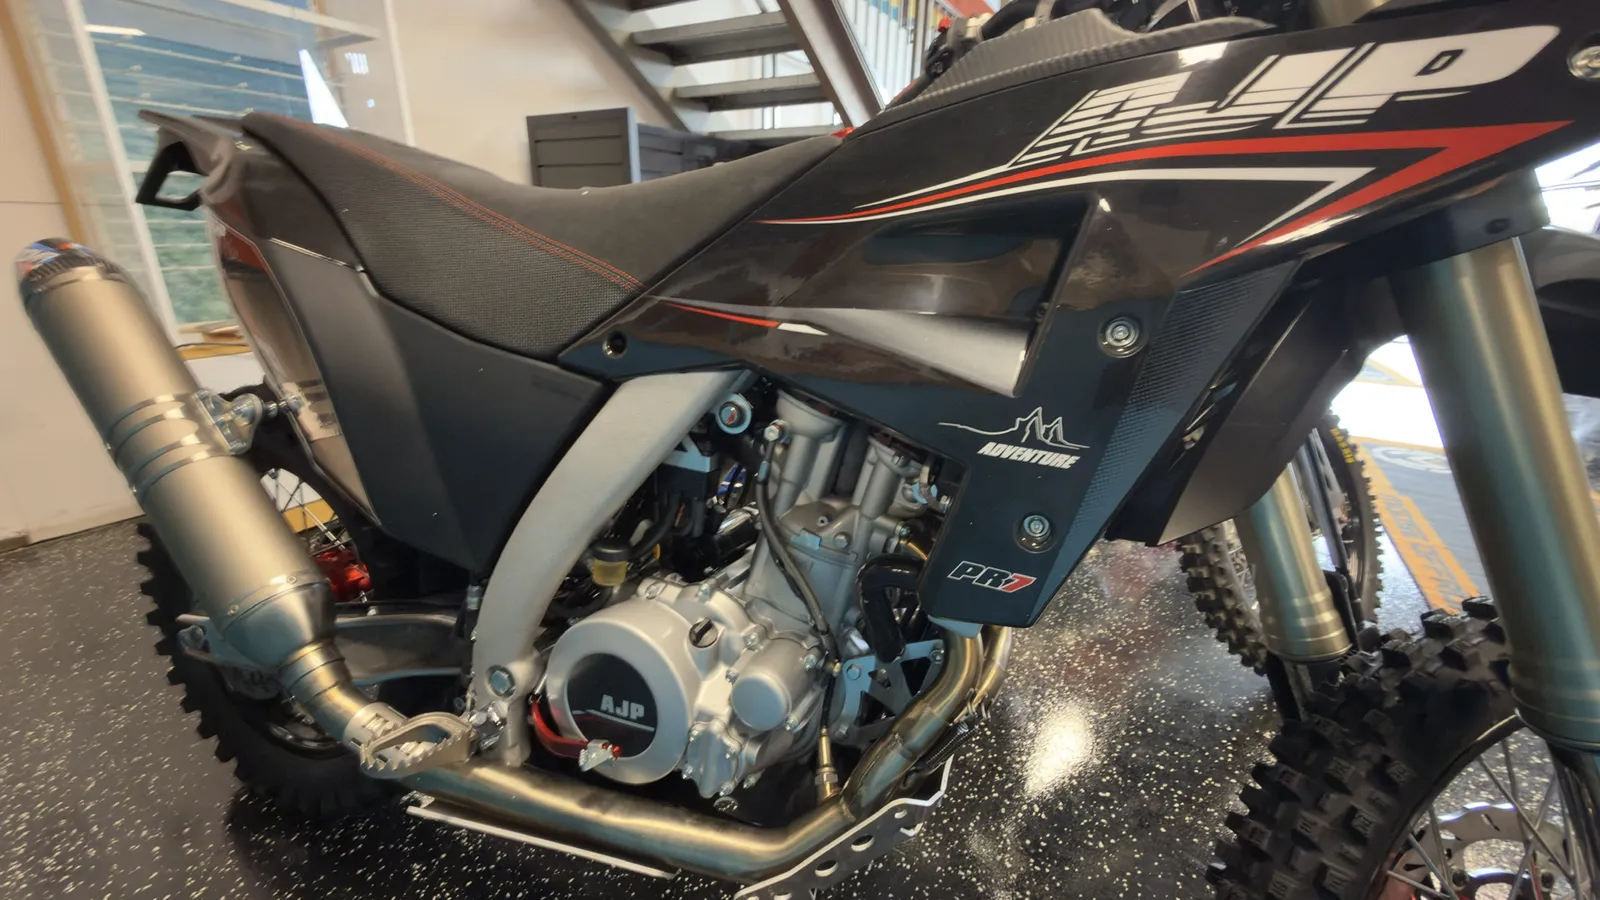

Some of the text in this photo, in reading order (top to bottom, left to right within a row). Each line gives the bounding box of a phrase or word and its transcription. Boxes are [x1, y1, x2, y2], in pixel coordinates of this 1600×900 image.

[1007, 25, 1560, 168] AJP
[977, 441, 1081, 470] ADVENTURE
[946, 560, 1038, 593] PR7
[600, 694, 645, 720] AJP
